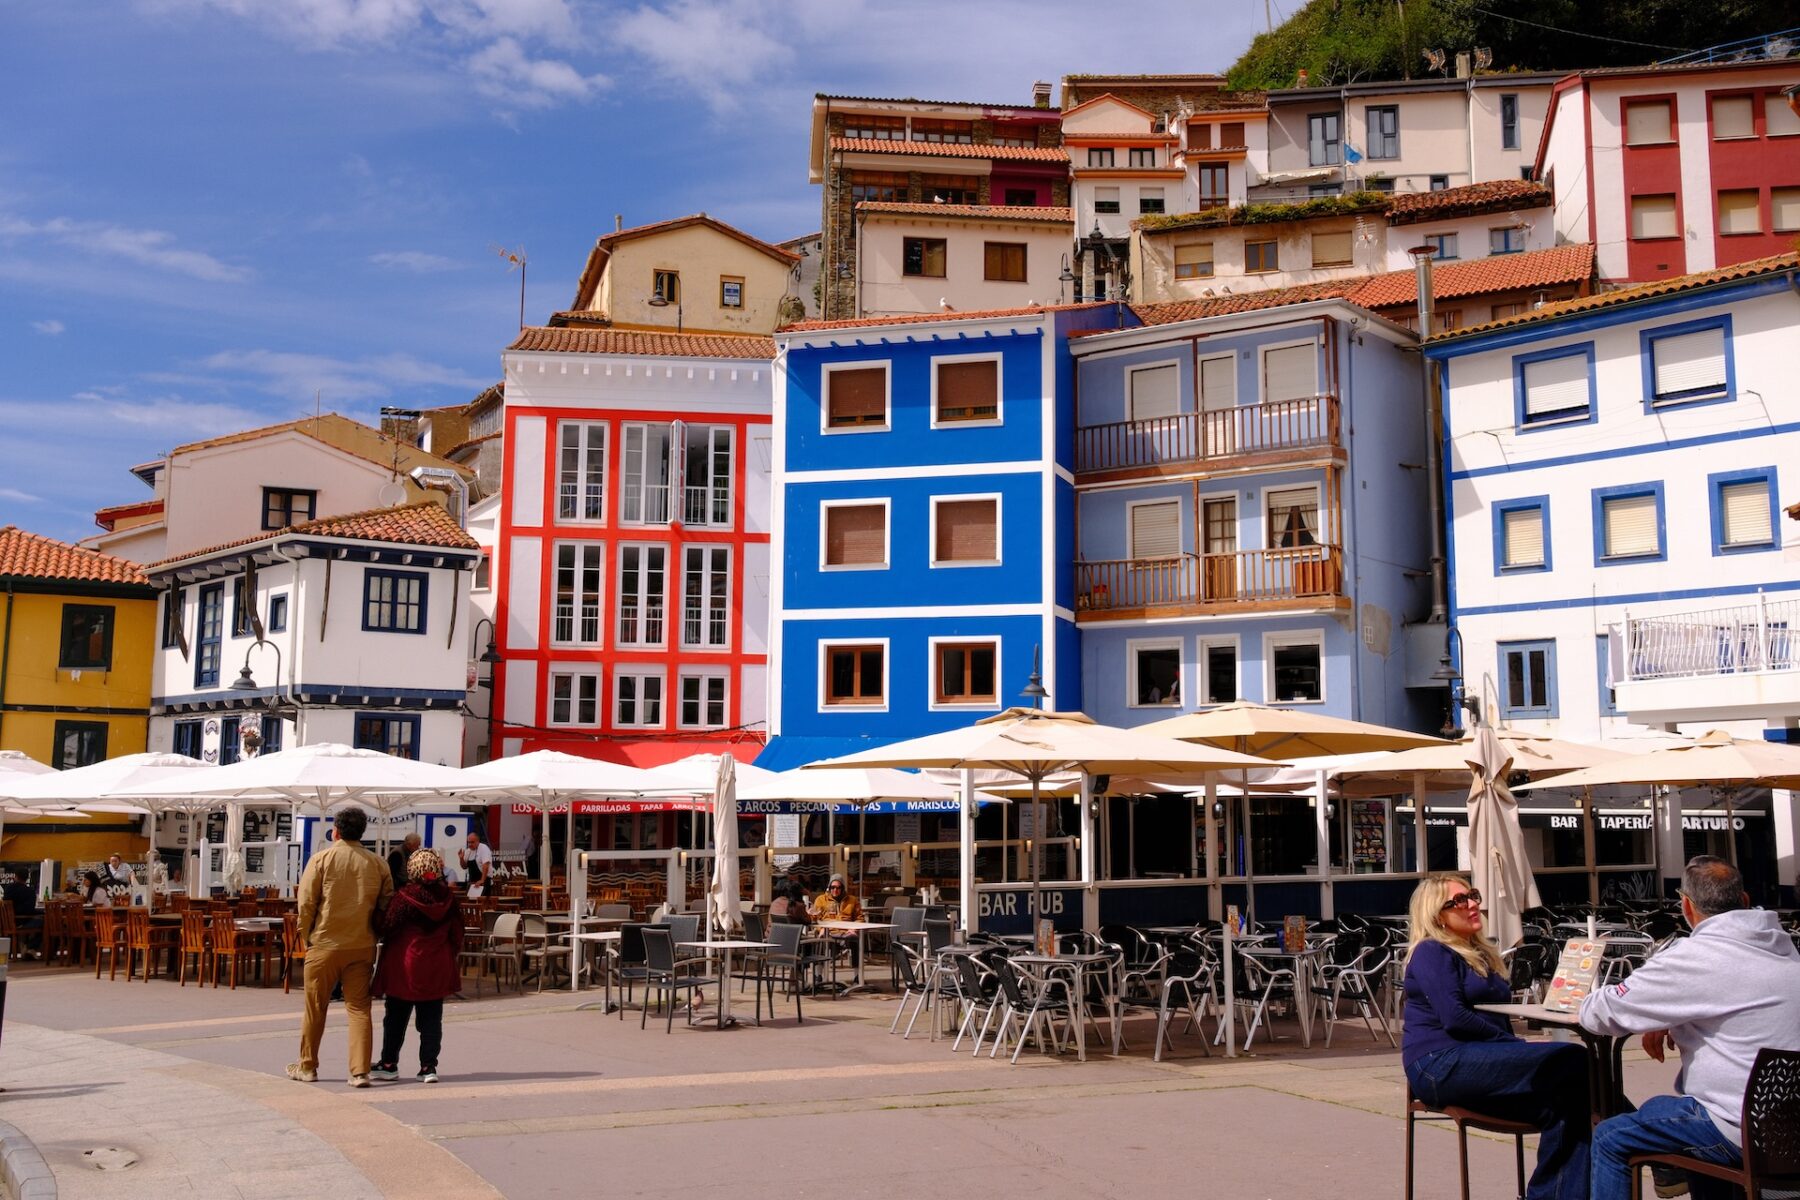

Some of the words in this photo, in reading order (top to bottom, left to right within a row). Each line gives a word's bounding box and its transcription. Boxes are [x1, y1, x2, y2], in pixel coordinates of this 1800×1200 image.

[513, 802, 532, 812] LOS
[581, 804, 631, 812] PARRILLADAS
[640, 803, 663, 811] TAPAS
[745, 801, 781, 812] ARCOS
[891, 801, 897, 811] Y
[907, 800, 960, 811] MARISCOS
[1551, 815, 1578, 828] BAR
[1682, 817, 1745, 830] ARTURO
[979, 893, 1017, 917] BAR
